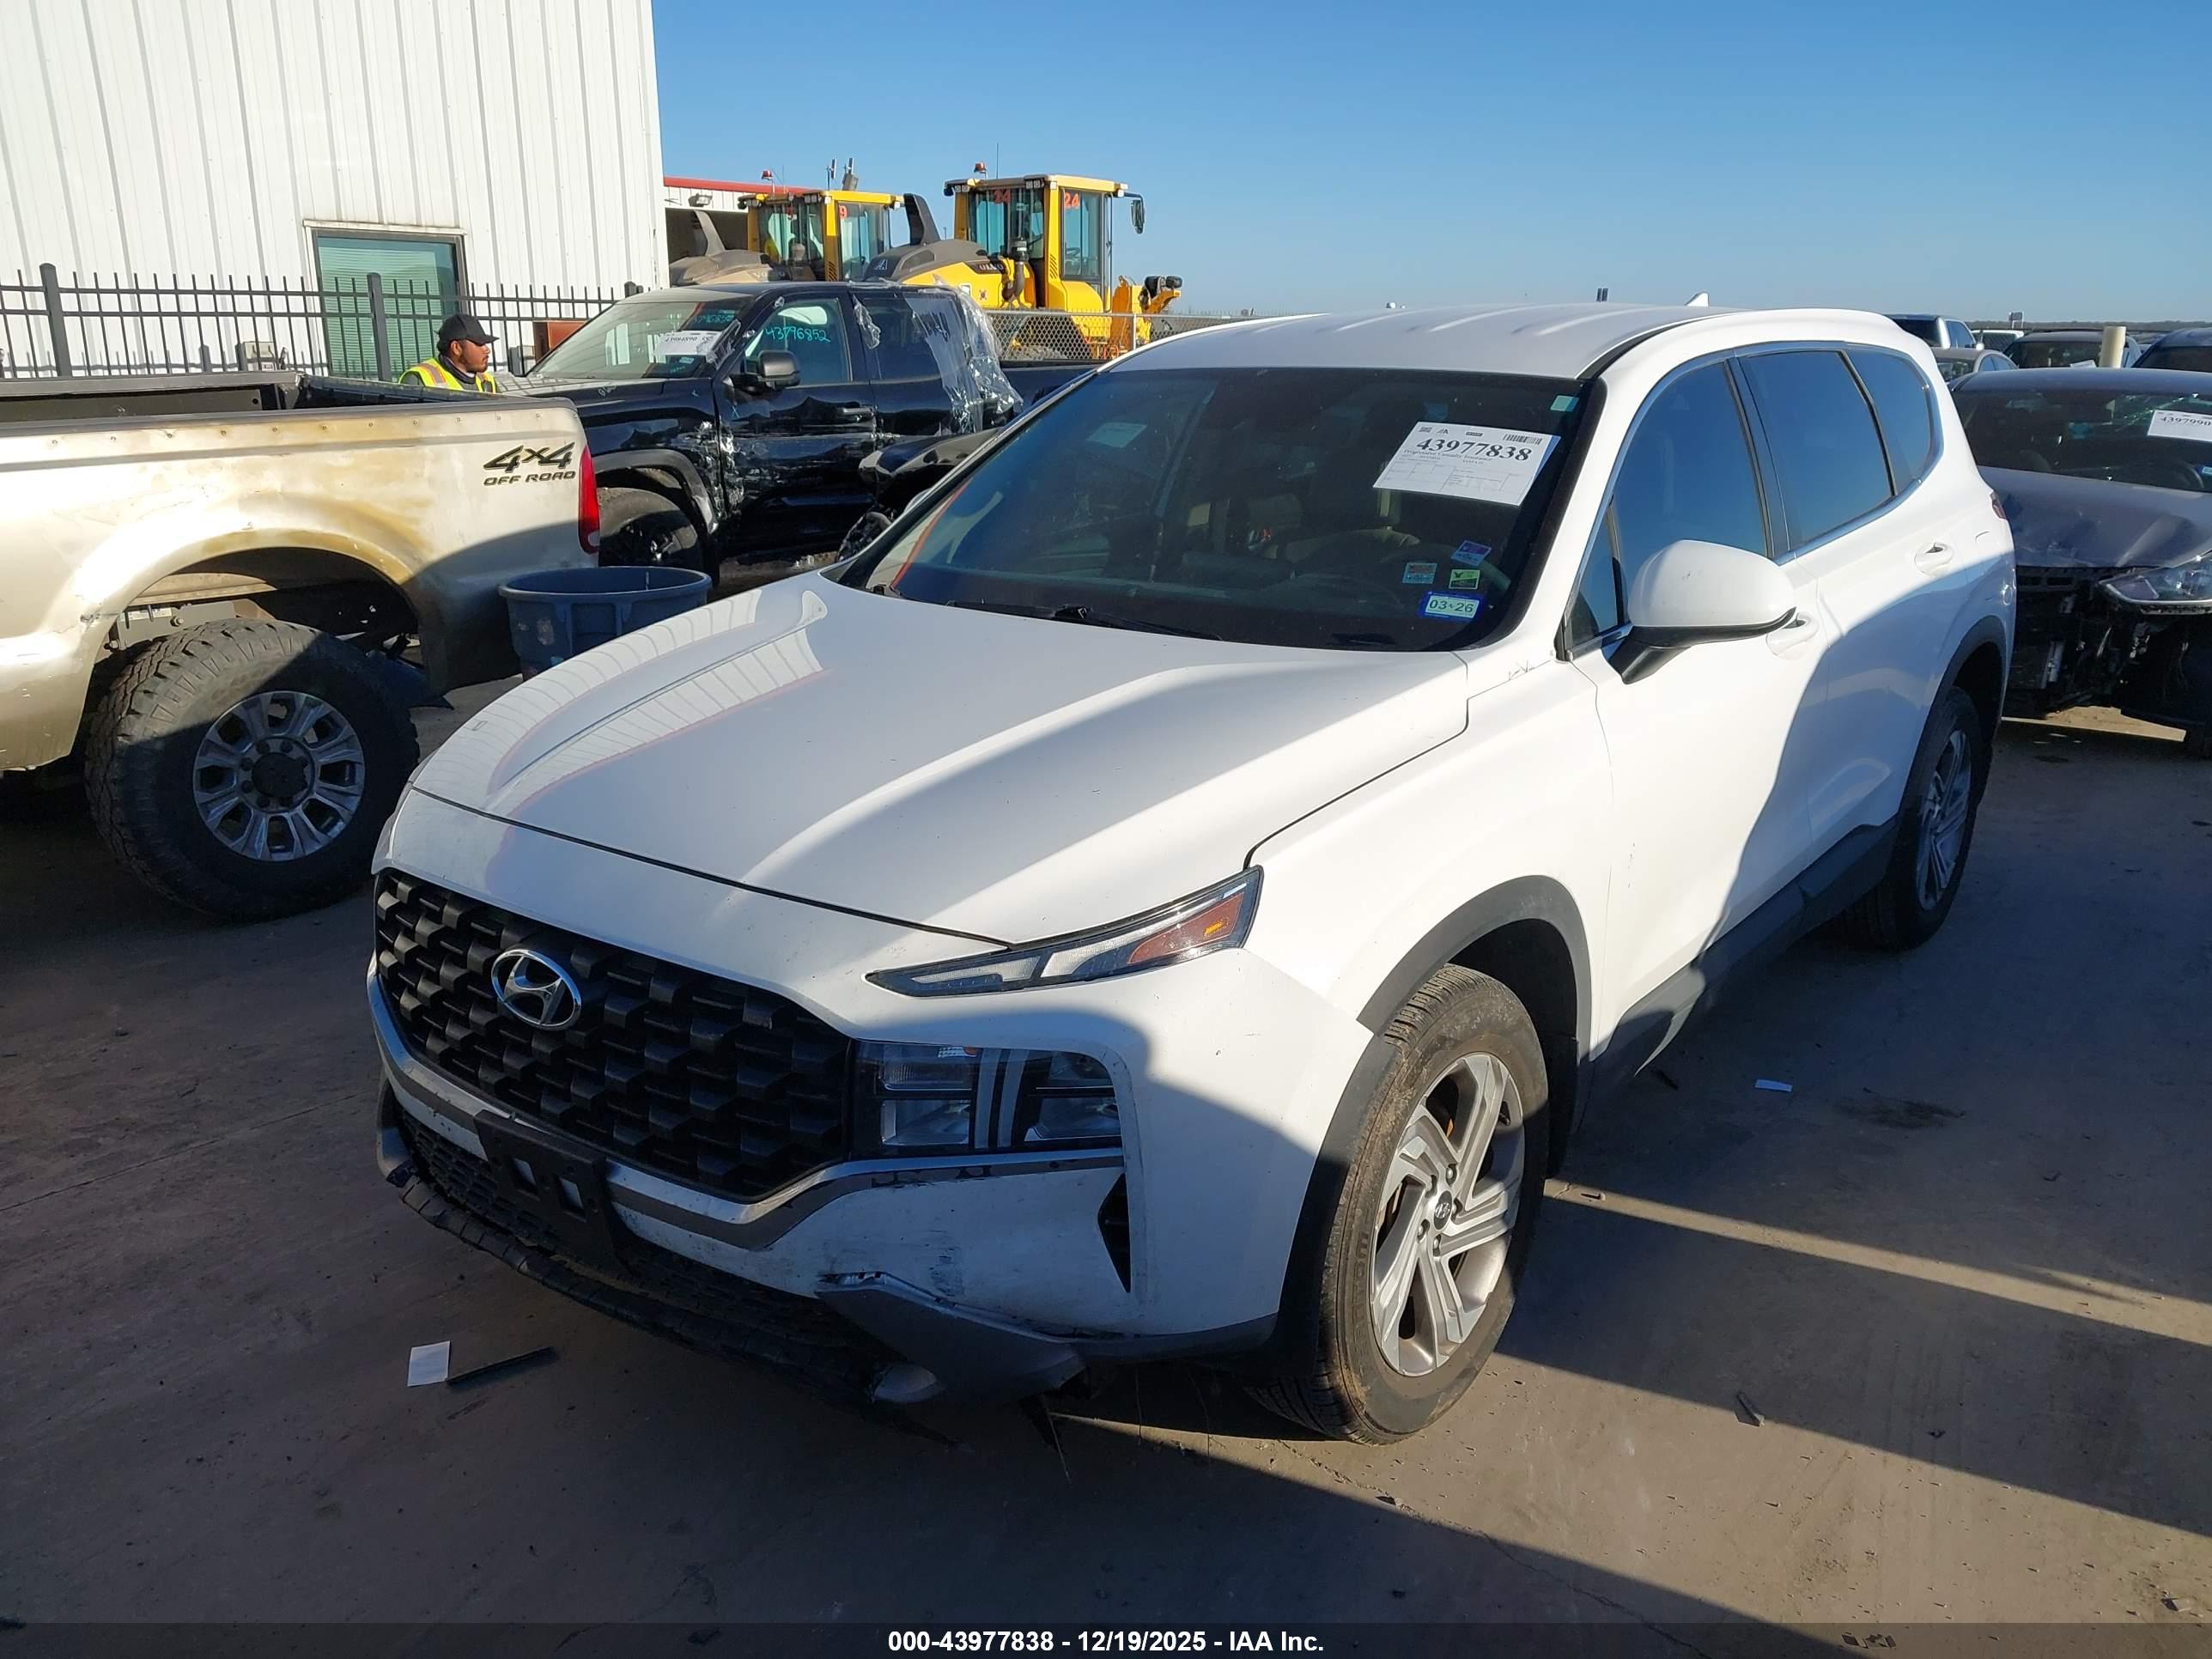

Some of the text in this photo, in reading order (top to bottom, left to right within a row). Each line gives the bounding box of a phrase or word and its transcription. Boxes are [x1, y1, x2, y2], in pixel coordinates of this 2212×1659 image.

[1064, 191, 1080, 209] 24
[839, 204, 848, 220] 9
[765, 325, 831, 343] 43796852
[1416, 437, 1533, 461] 43977838
[483, 471, 576, 486] OFF ROAD
